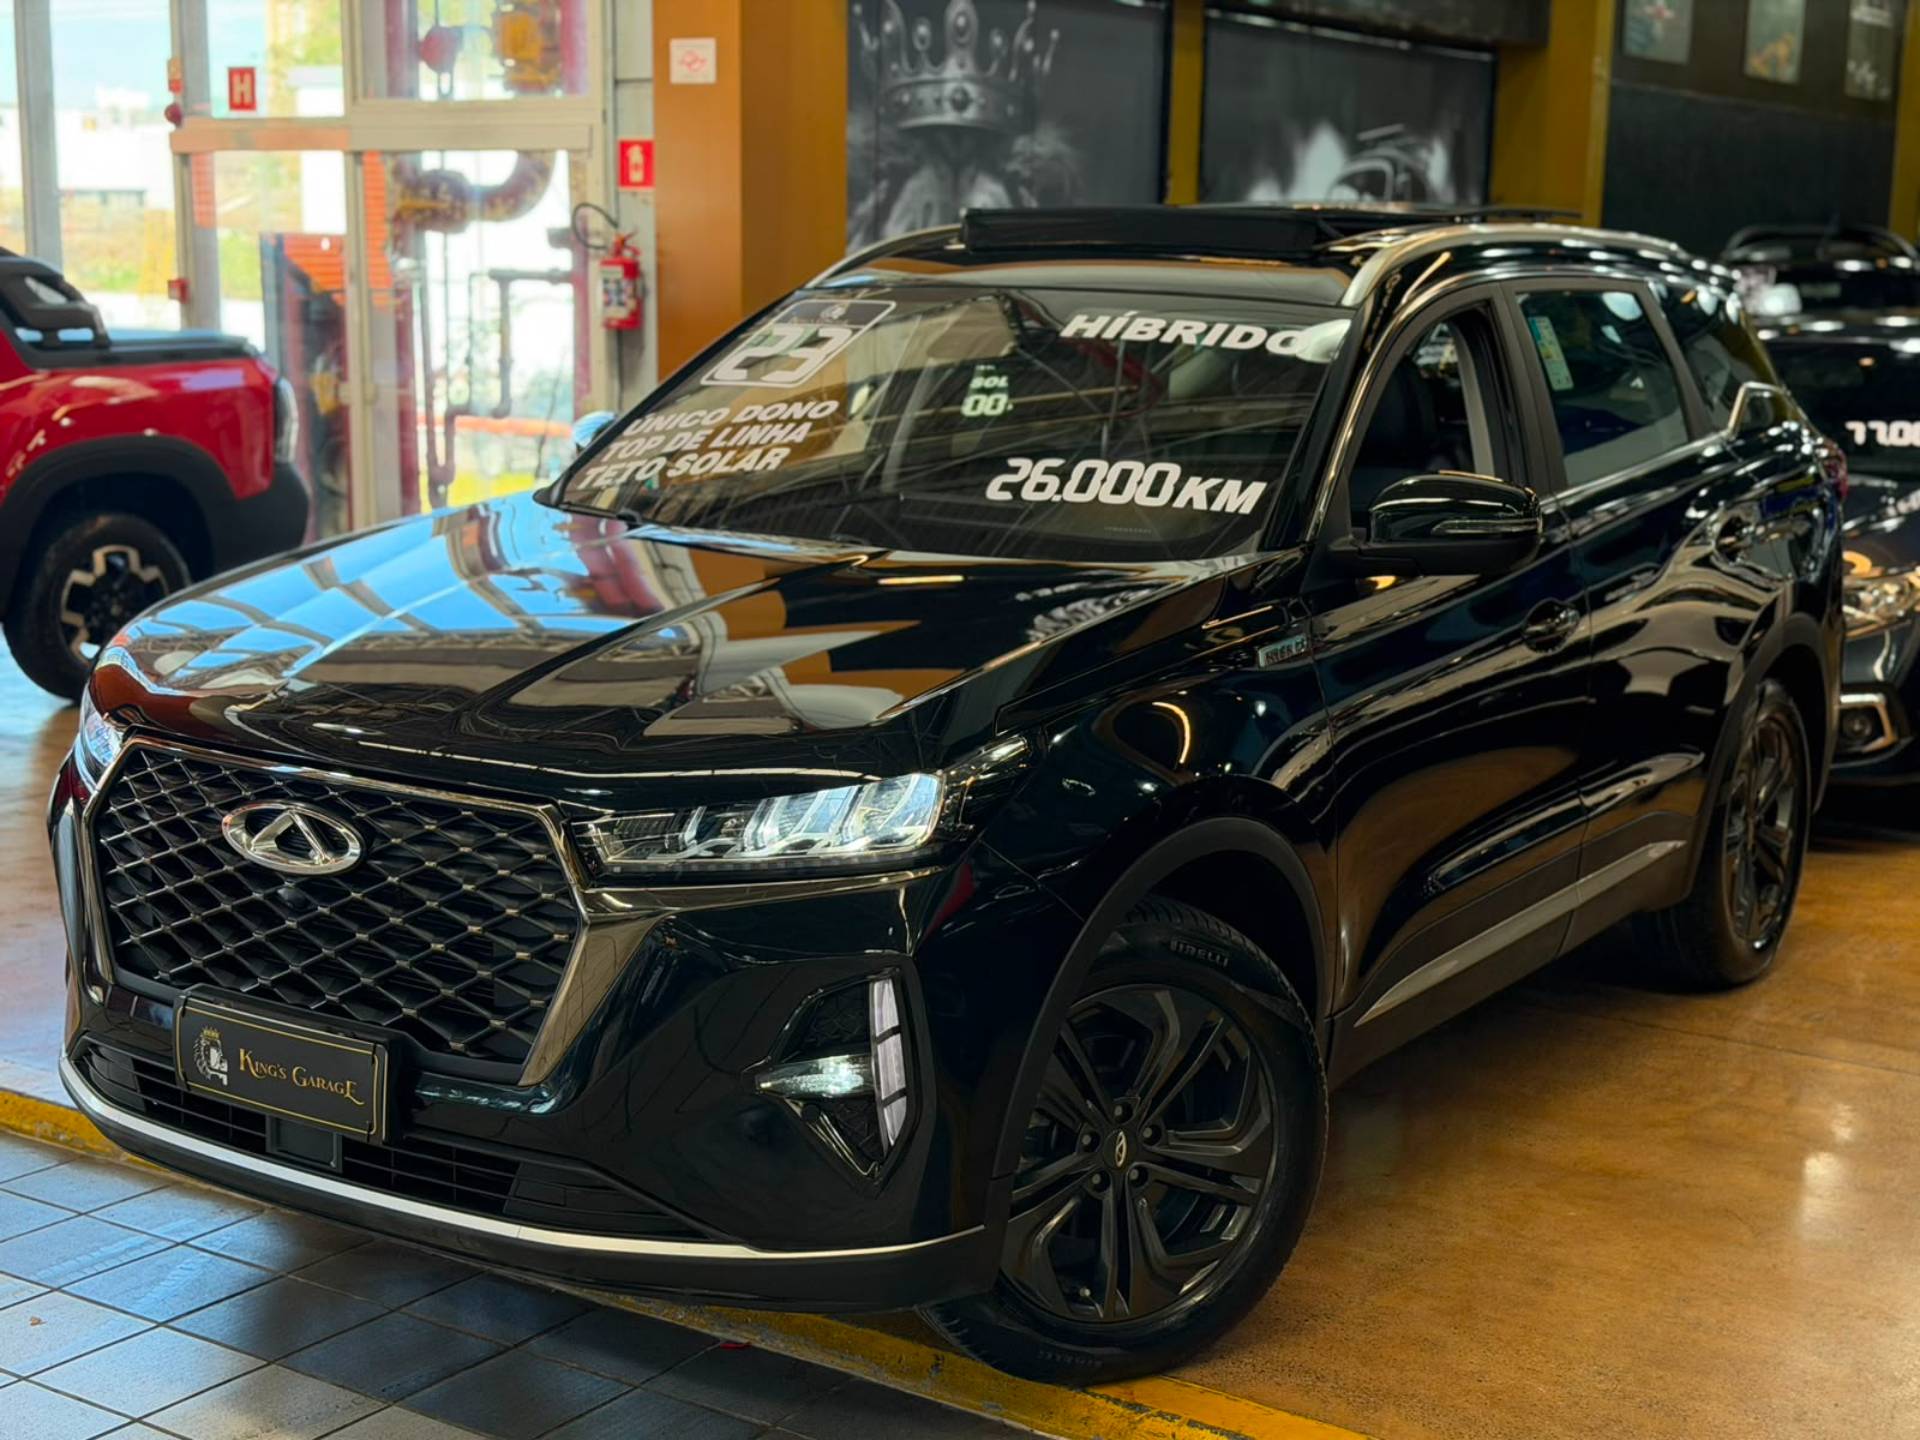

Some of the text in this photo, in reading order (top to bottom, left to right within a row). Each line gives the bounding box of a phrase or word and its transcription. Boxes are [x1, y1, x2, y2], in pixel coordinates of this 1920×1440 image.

[232, 71, 252, 104] H
[714, 324, 853, 382] 23
[1059, 310, 1310, 356] HÍBRIDO
[731, 400, 840, 423] DONO
[601, 421, 812, 462] TOP DE LINHA
[577, 447, 792, 490] TETO SOLAR
